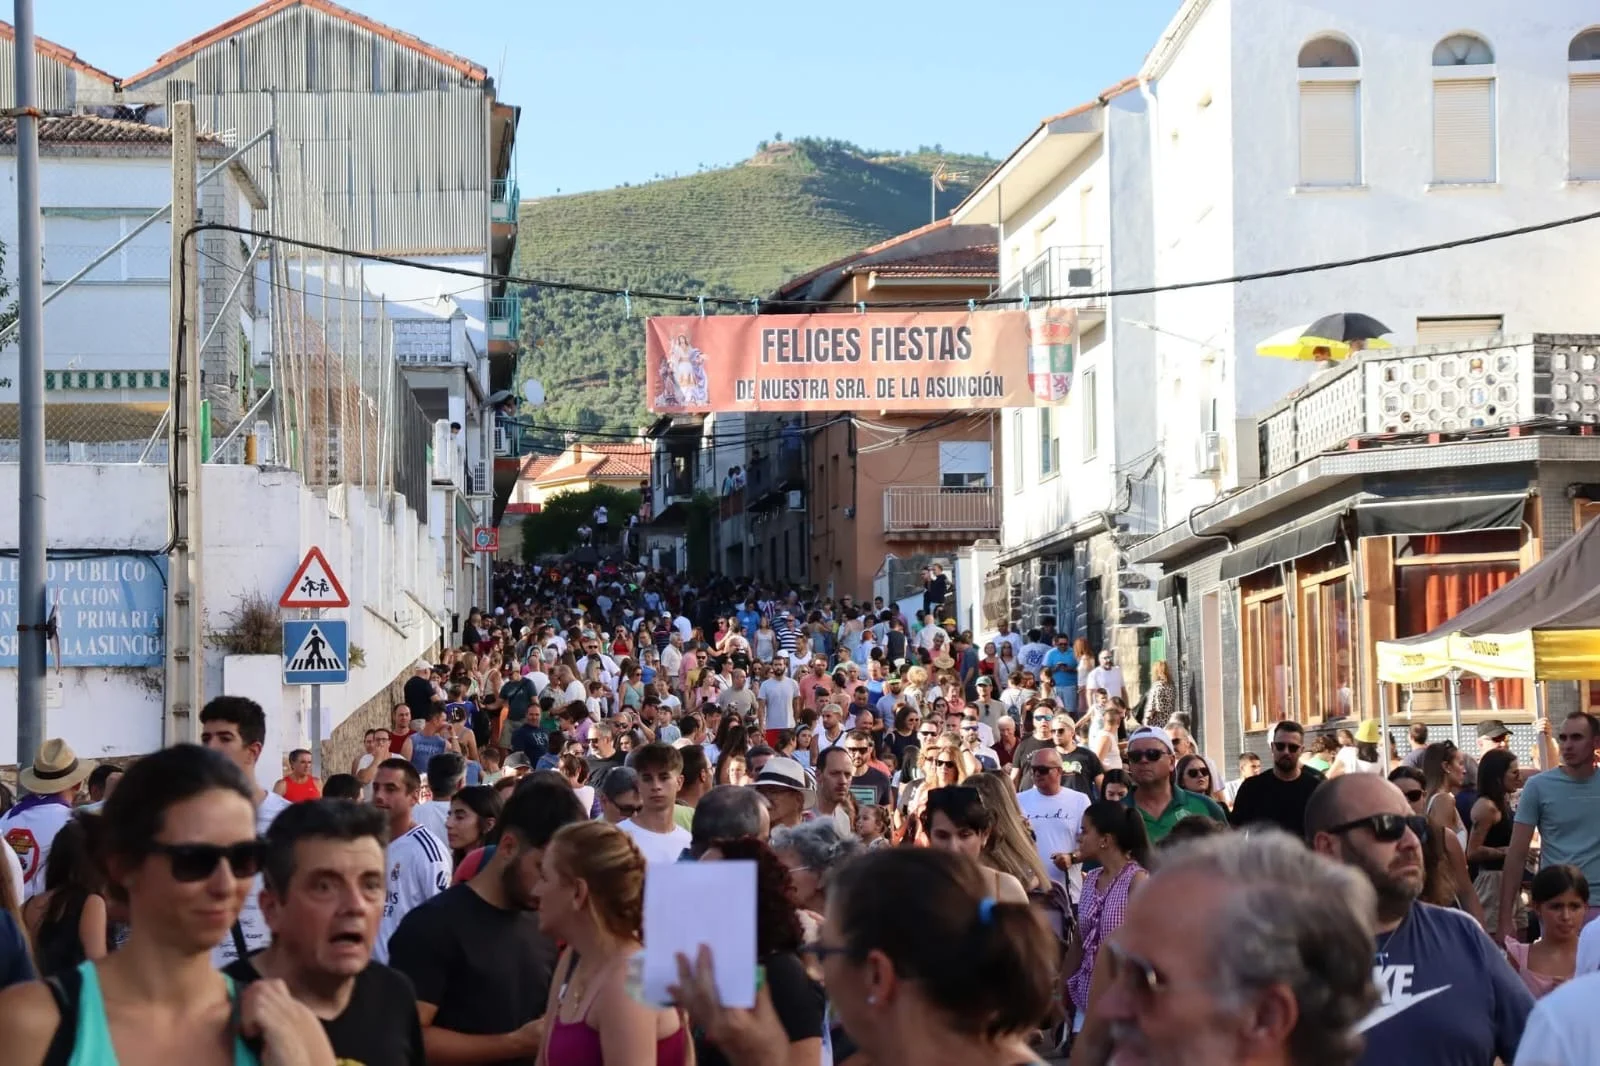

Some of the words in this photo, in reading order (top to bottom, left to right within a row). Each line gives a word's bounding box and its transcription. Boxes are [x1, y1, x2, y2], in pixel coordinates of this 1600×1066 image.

[762, 327, 861, 363] FELICES
[871, 325, 972, 361] FIESTAS
[736, 380, 756, 400] DE
[761, 378, 829, 400] NUESTRA
[835, 377, 871, 399] SRA.
[876, 378, 896, 398] DE
[901, 377, 920, 398] LA
[925, 370, 1004, 398] ASUNCIÓN
[78, 609, 160, 629] PRIMARIA
[1372, 964, 1415, 1004] KE
